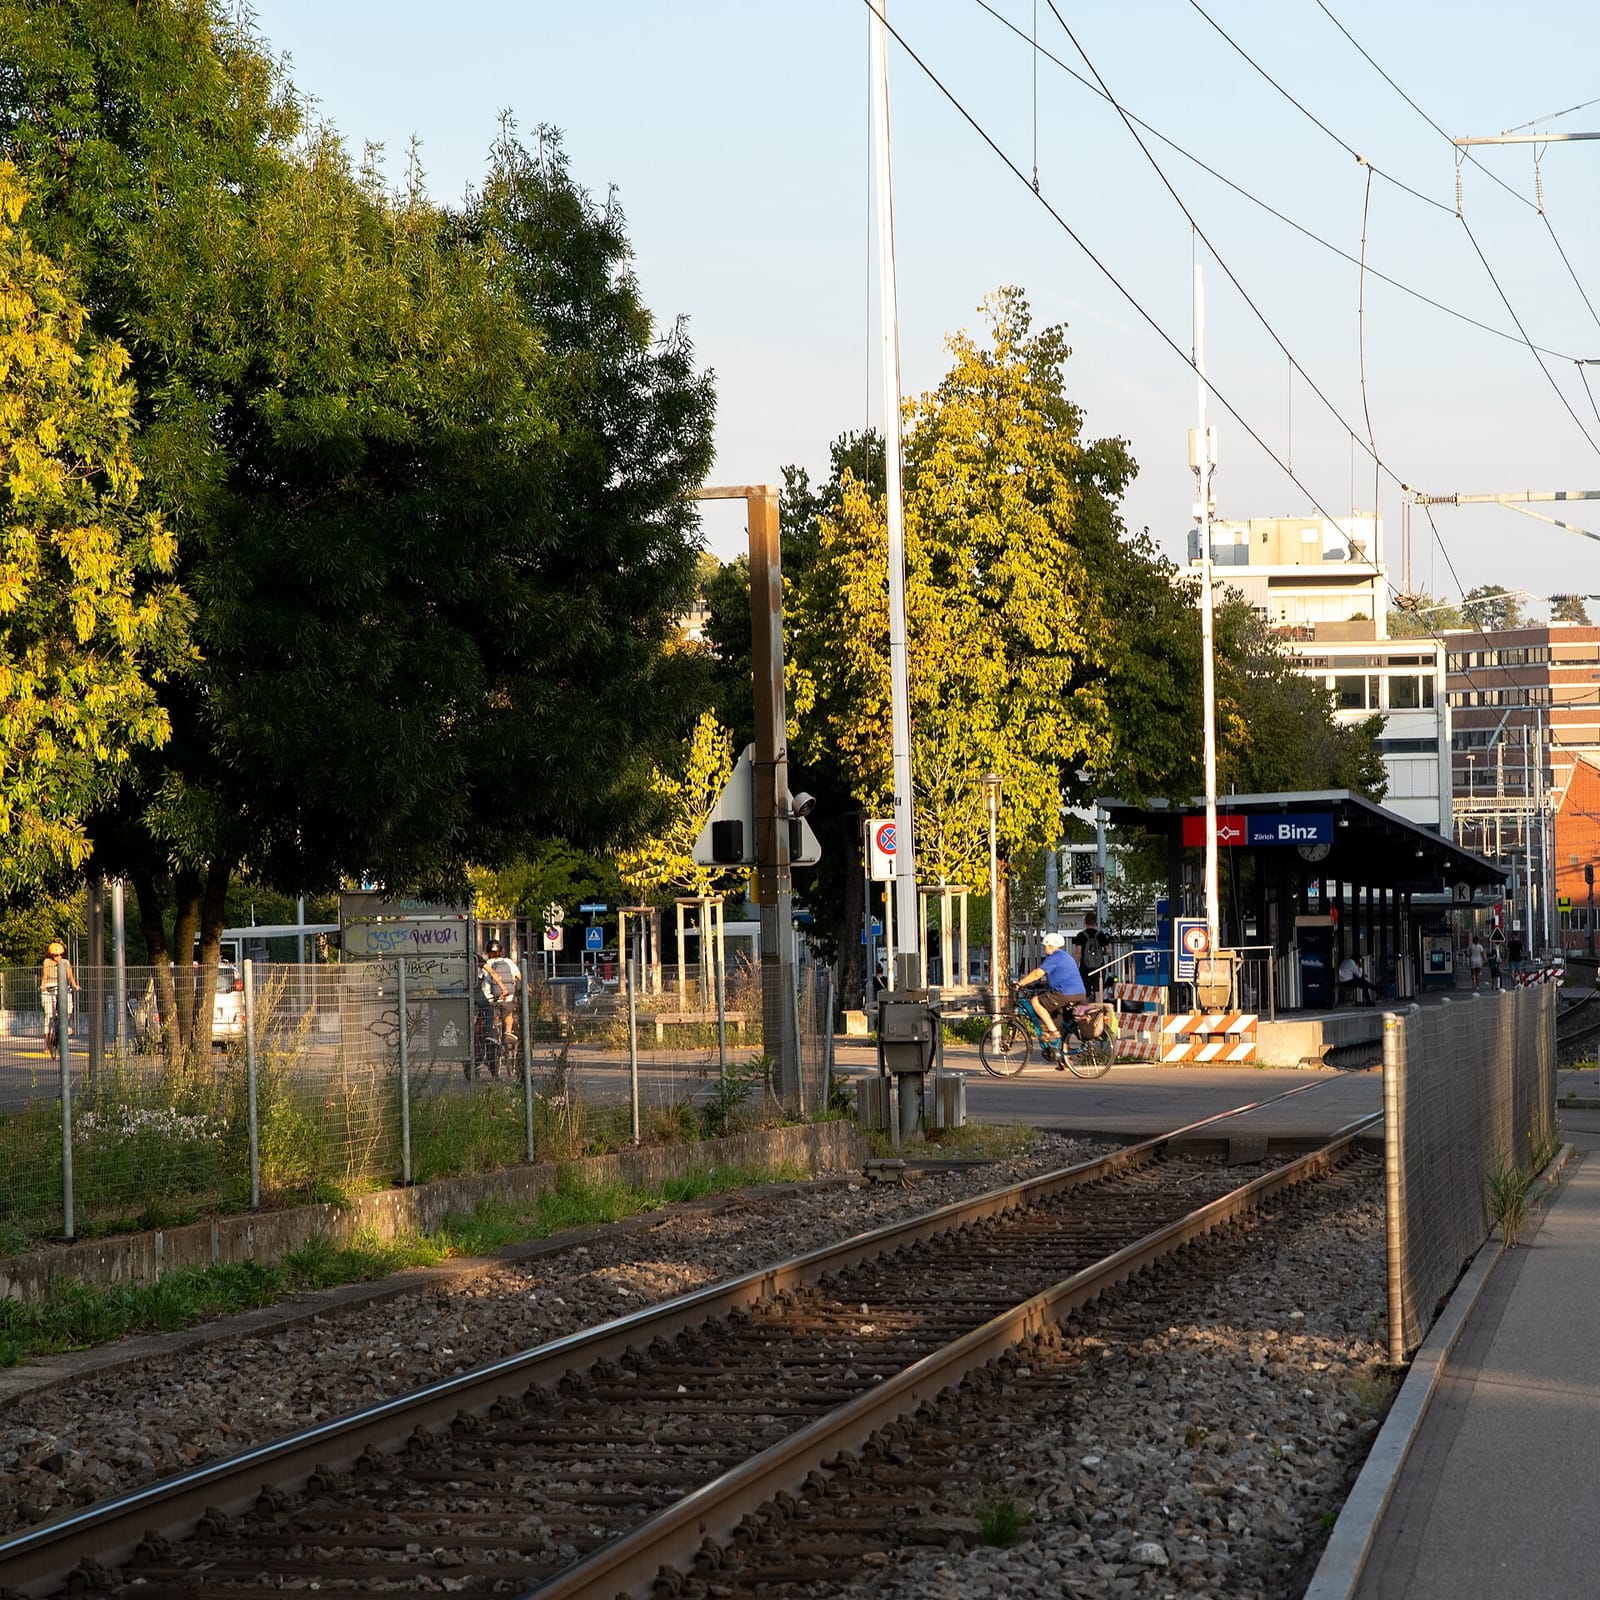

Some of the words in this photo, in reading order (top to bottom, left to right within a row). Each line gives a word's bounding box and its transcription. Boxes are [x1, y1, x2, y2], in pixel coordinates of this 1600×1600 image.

[1254, 833, 1275, 841] Zürich
[1278, 824, 1318, 840] Binz
[1458, 886, 1467, 900] K
